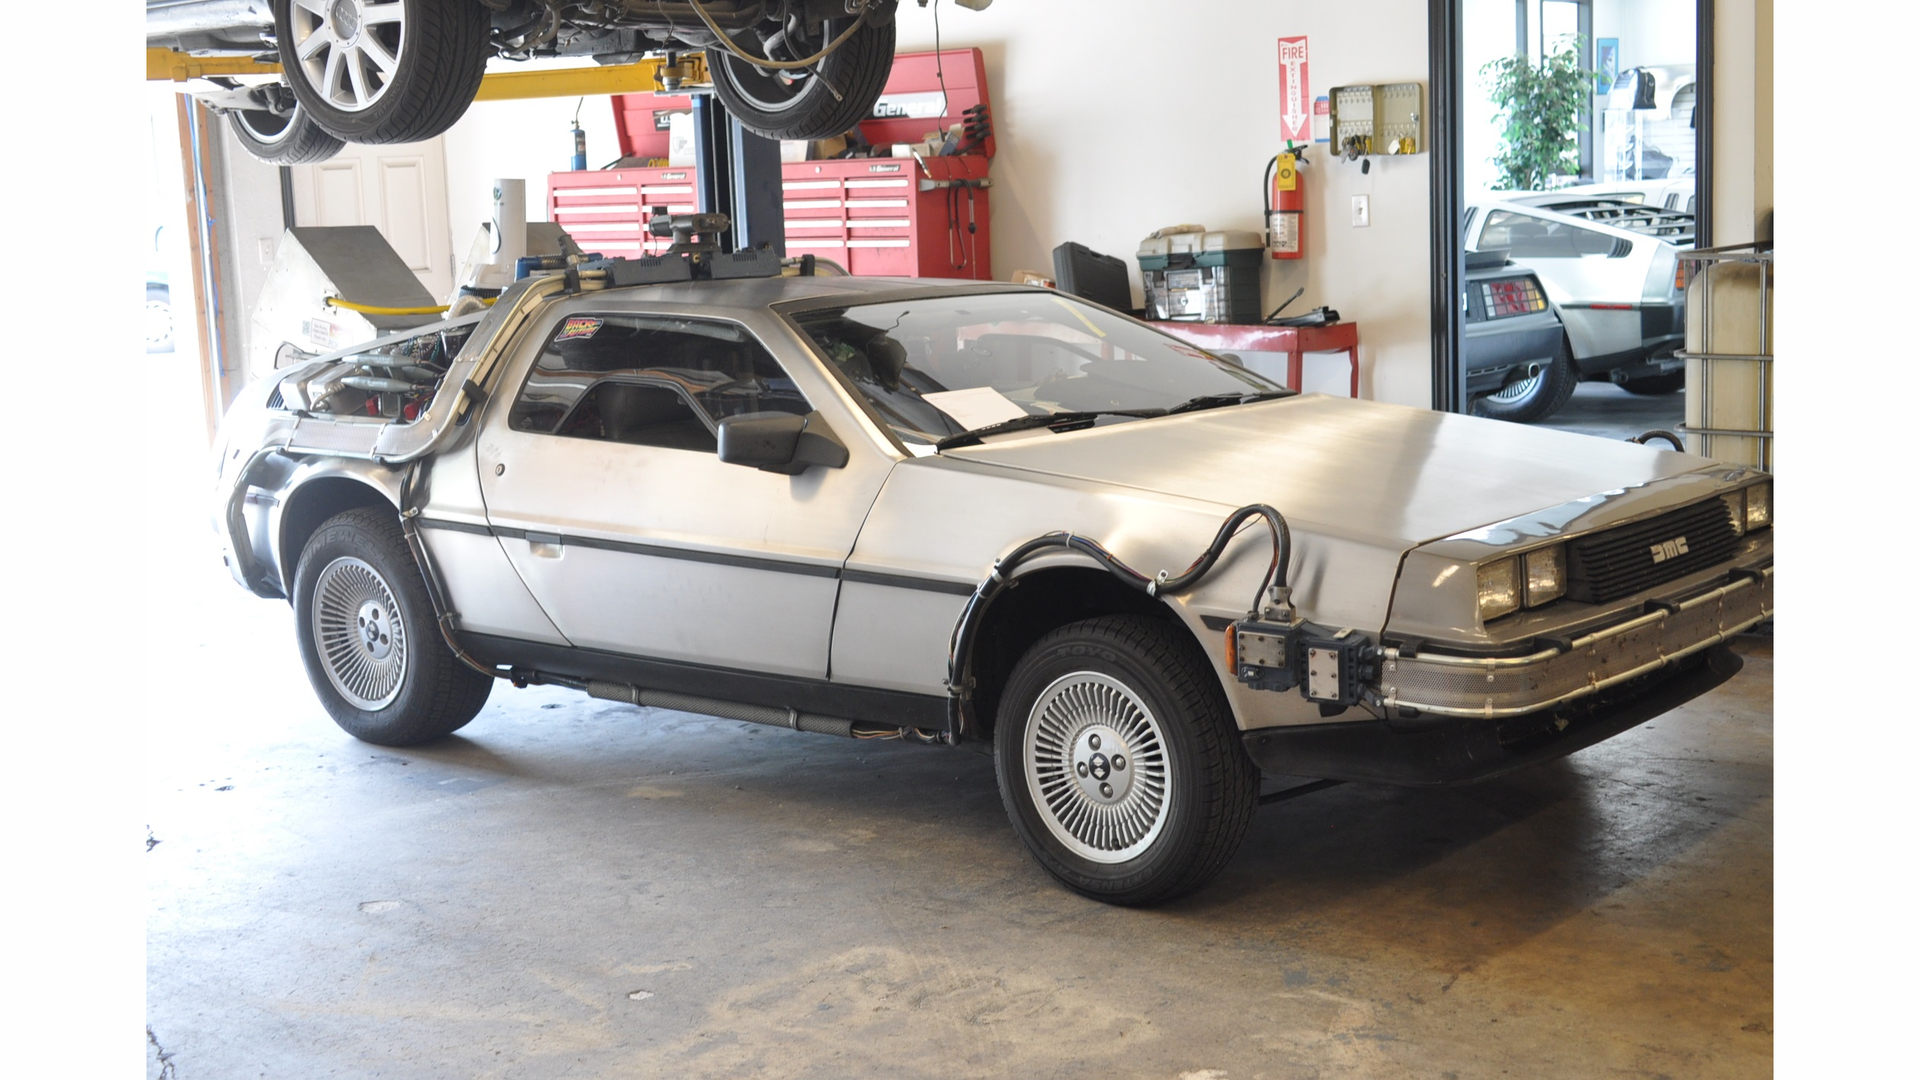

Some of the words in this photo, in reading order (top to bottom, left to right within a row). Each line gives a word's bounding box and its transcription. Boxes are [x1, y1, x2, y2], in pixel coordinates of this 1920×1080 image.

[1283, 46, 1304, 60] FIRE
[1290, 61, 1298, 131] EXTINGUISHER
[873, 97, 943, 117] General
[1650, 536, 1689, 564] DMC
[1057, 646, 1116, 662] TOYO
